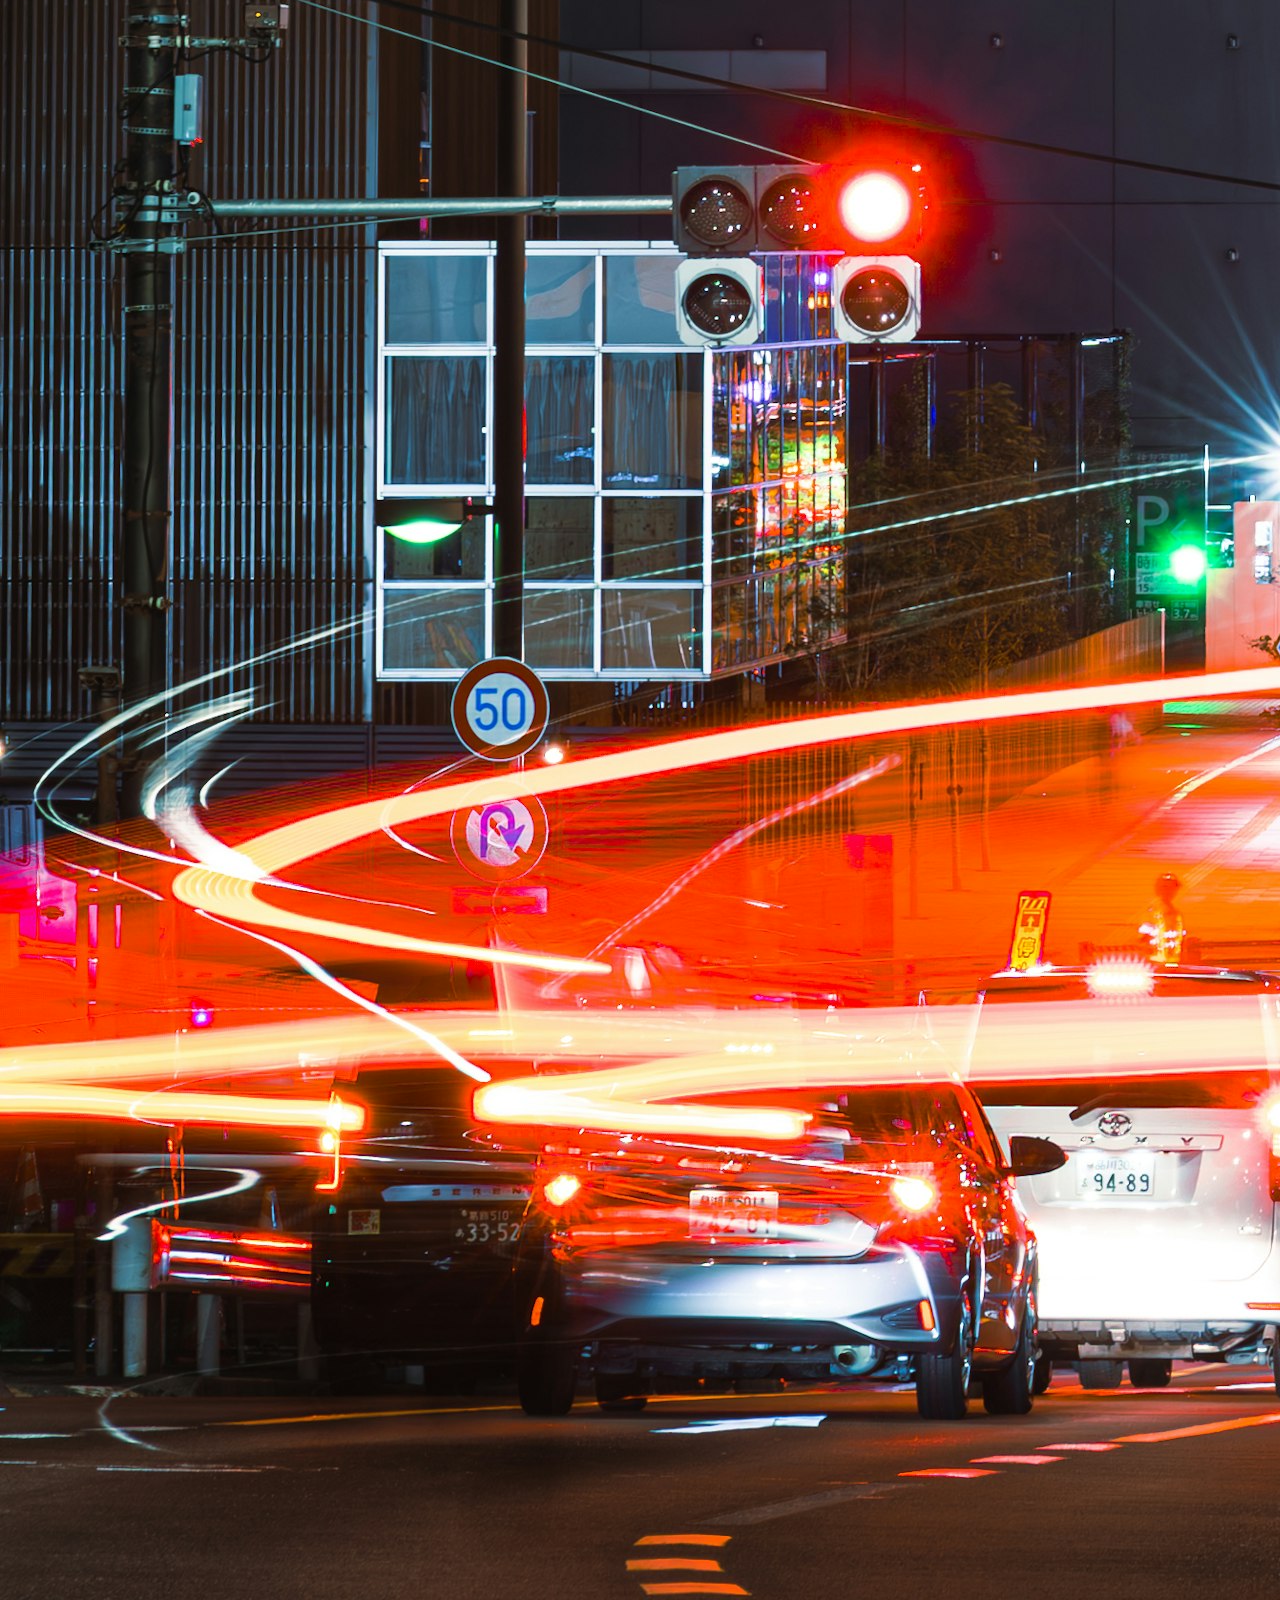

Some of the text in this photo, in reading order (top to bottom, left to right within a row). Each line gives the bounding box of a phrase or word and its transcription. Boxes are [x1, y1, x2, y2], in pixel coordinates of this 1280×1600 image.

[1136, 495, 1170, 547] P
[475, 687, 527, 732] 50
[1093, 1173, 1151, 1192] 94-89
[467, 1222, 520, 1242] 33-52
